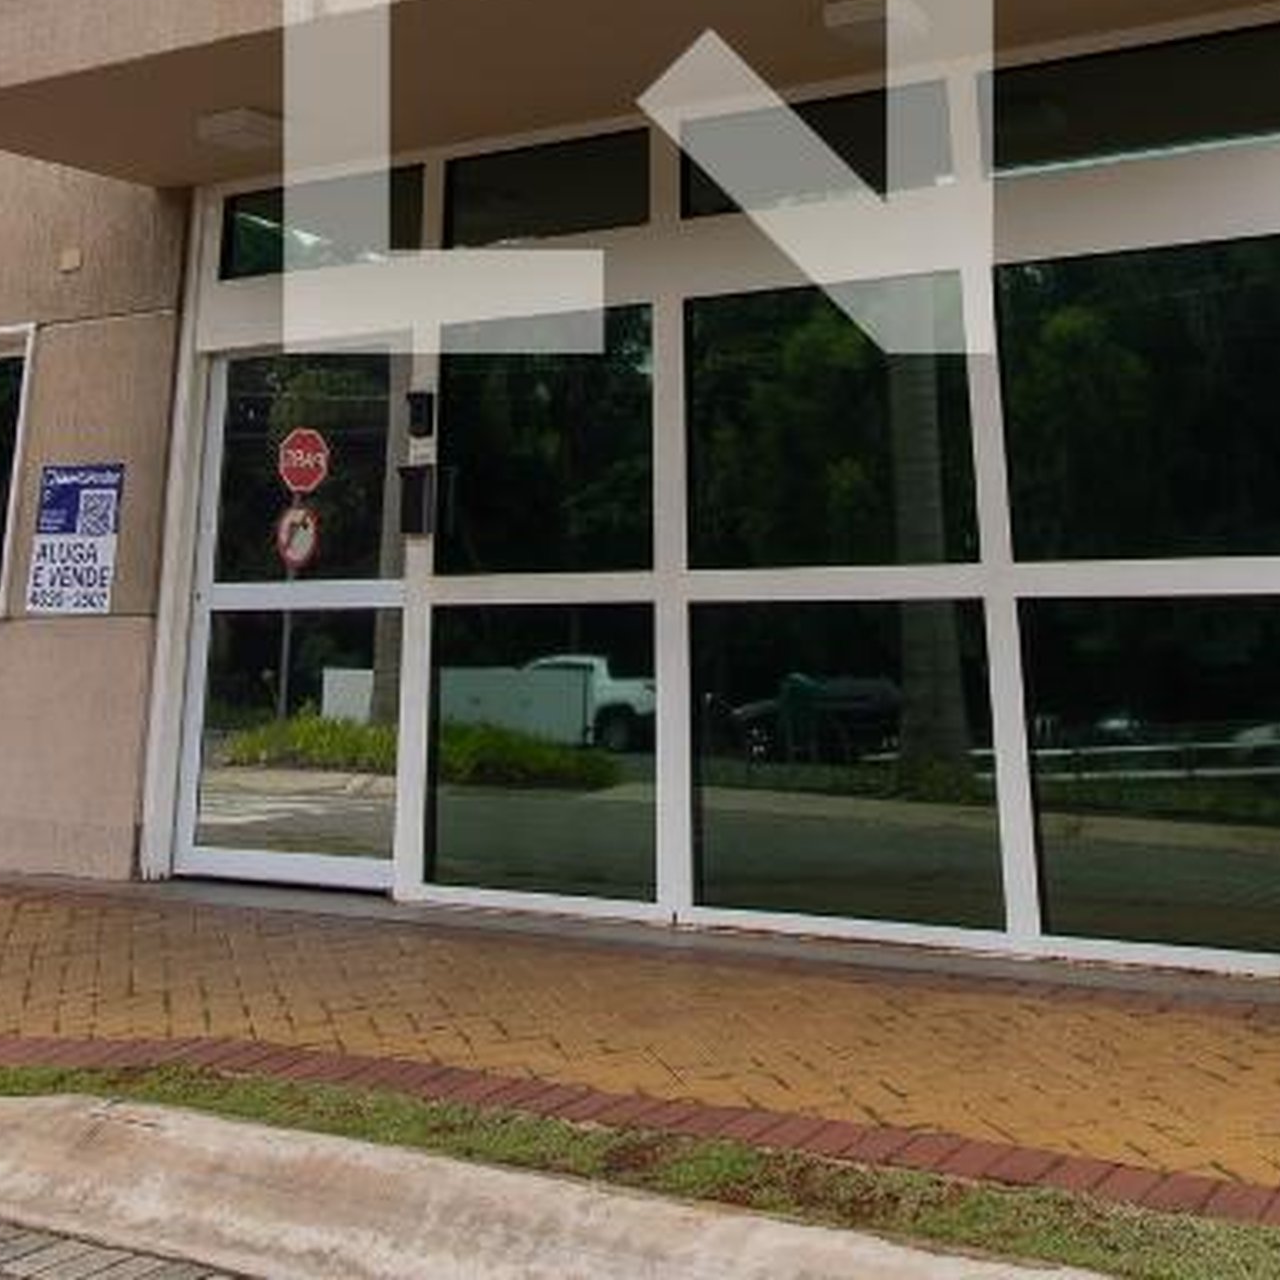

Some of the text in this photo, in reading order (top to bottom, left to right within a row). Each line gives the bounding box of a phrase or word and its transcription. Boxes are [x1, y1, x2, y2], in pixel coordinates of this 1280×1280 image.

[35, 541, 99, 565] ALUGA
[32, 566, 111, 589] E VENDE
